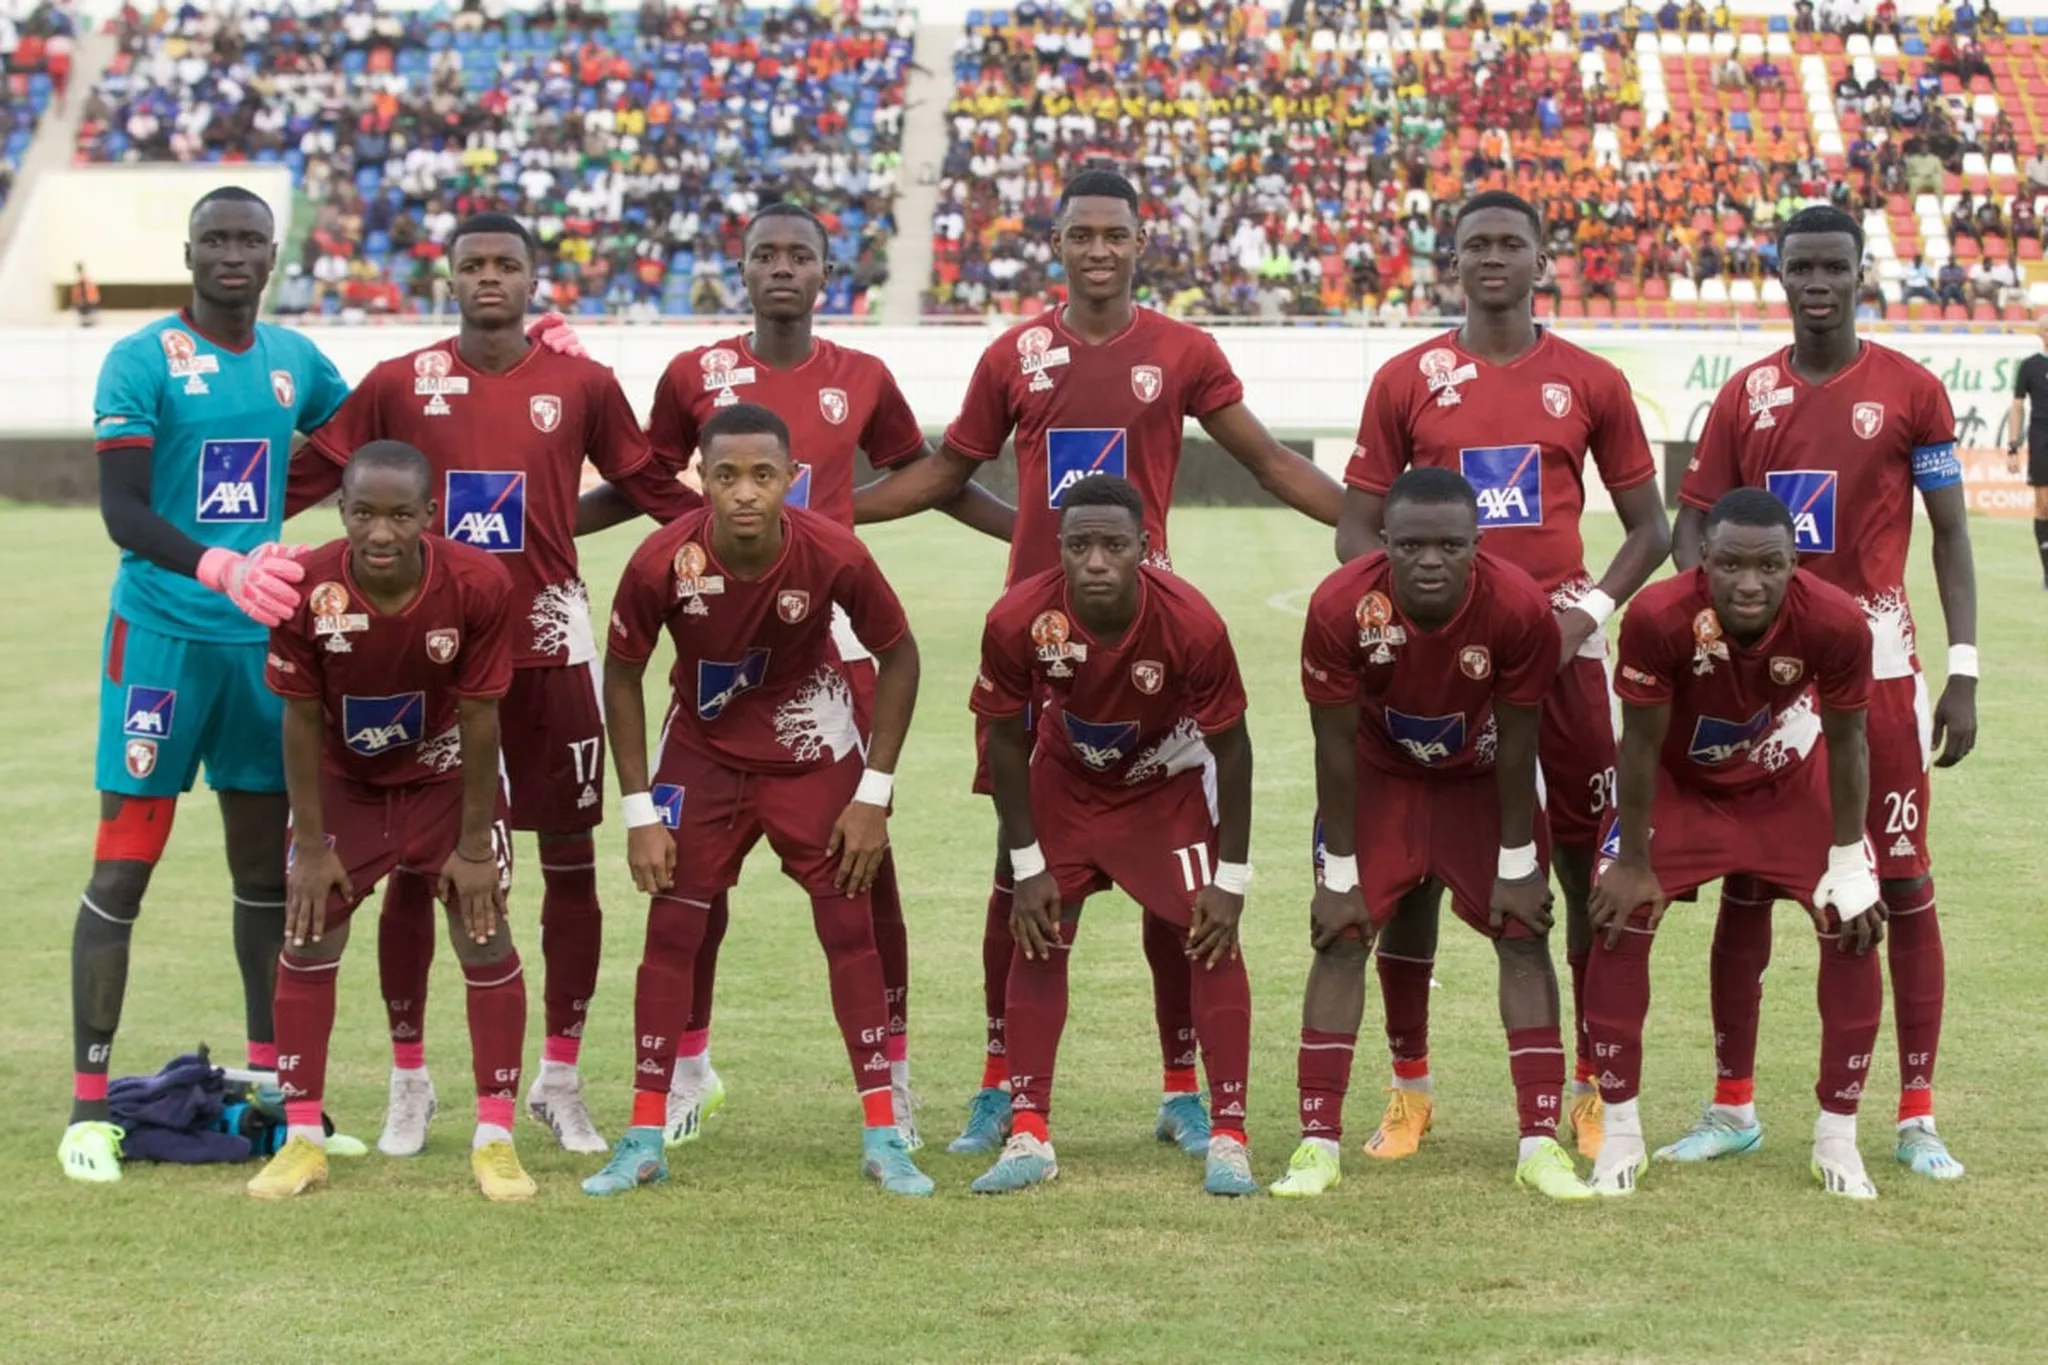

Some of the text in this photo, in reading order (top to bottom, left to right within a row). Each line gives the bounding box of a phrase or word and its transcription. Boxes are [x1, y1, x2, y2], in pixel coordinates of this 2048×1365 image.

[1942, 357, 1982, 391] du
[199, 481, 259, 514] AXA
[1476, 486, 1530, 519] AXA
[447, 511, 512, 544] AXA
[125, 709, 163, 733] AXA
[348, 723, 409, 750] AXA
[567, 736, 599, 784] 17
[1884, 788, 1919, 834] 26
[1172, 842, 1212, 891] 11
[641, 1035, 667, 1050] GF
[861, 1026, 885, 1043] GF
[88, 1043, 110, 1063] GF
[1595, 1042, 1623, 1058] GF
[1908, 1052, 1930, 1066] GF
[278, 1054, 301, 1070] GF
[1847, 1053, 1872, 1069] GF
[494, 1067, 520, 1081] GF
[1222, 1081, 1244, 1093] GF
[1303, 1097, 1325, 1112] GF
[1537, 1094, 1558, 1109] GF
